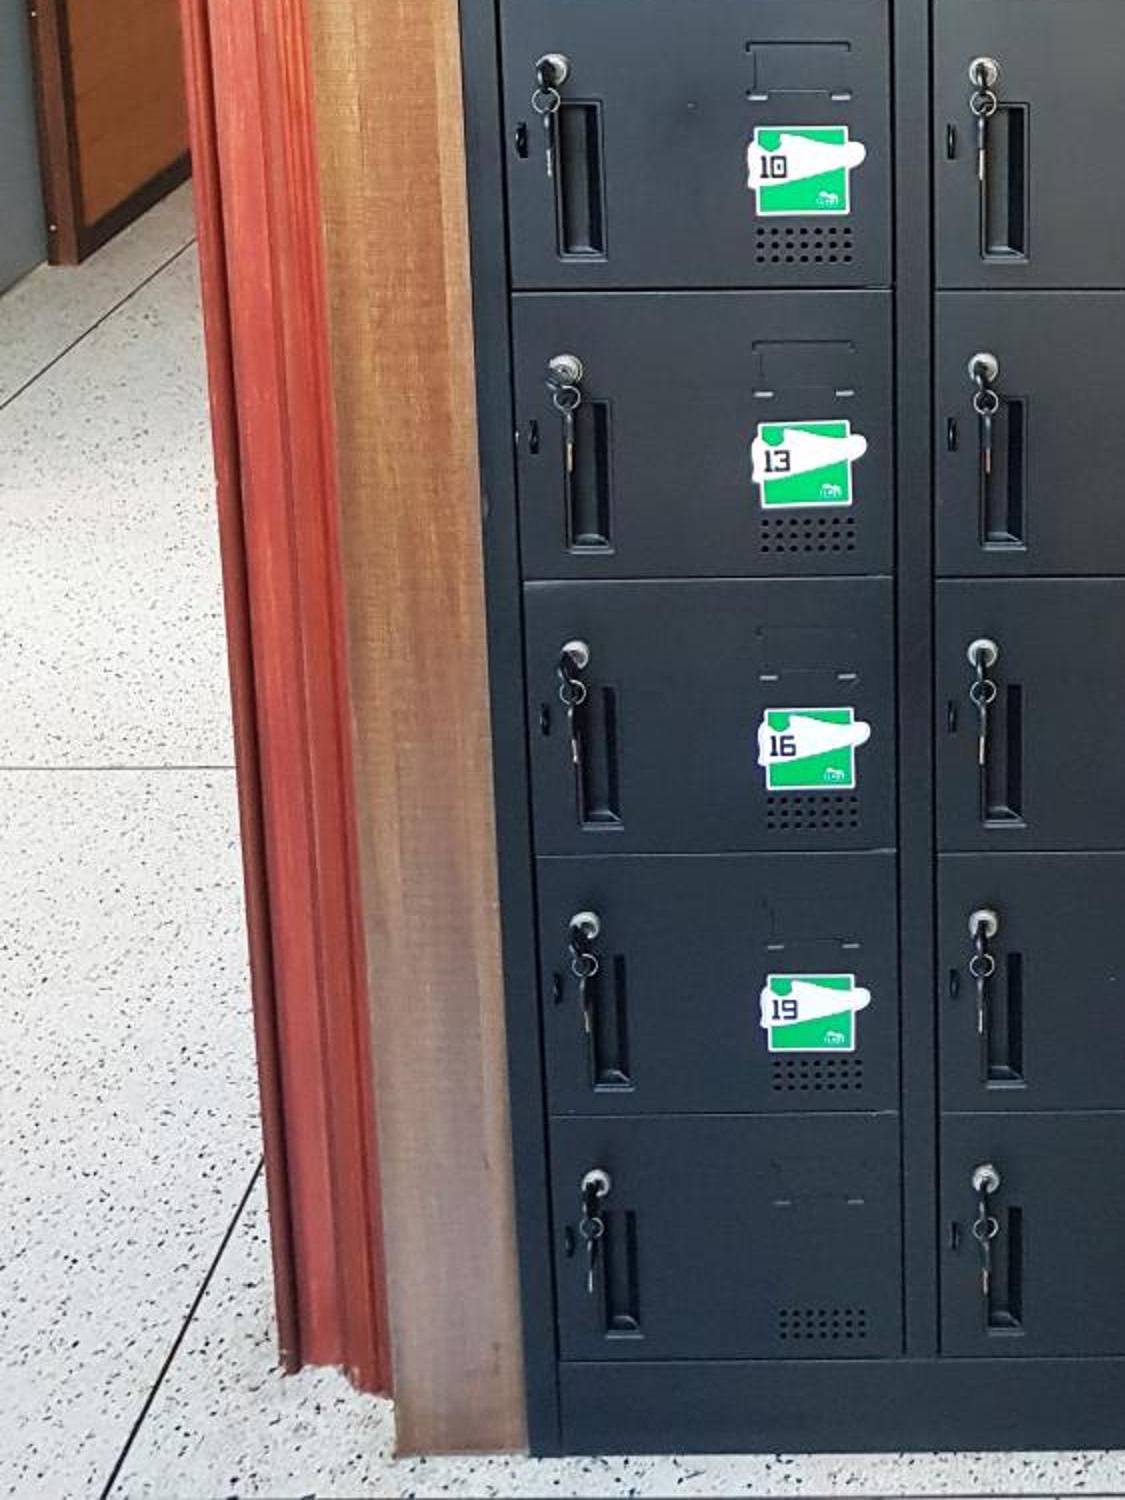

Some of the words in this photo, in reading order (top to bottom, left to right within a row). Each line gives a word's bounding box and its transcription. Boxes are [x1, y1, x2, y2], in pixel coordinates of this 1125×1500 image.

[760, 155, 788, 179] 10
[764, 449, 791, 473] 13
[770, 735, 797, 757] 16
[772, 999, 798, 1021] 19
